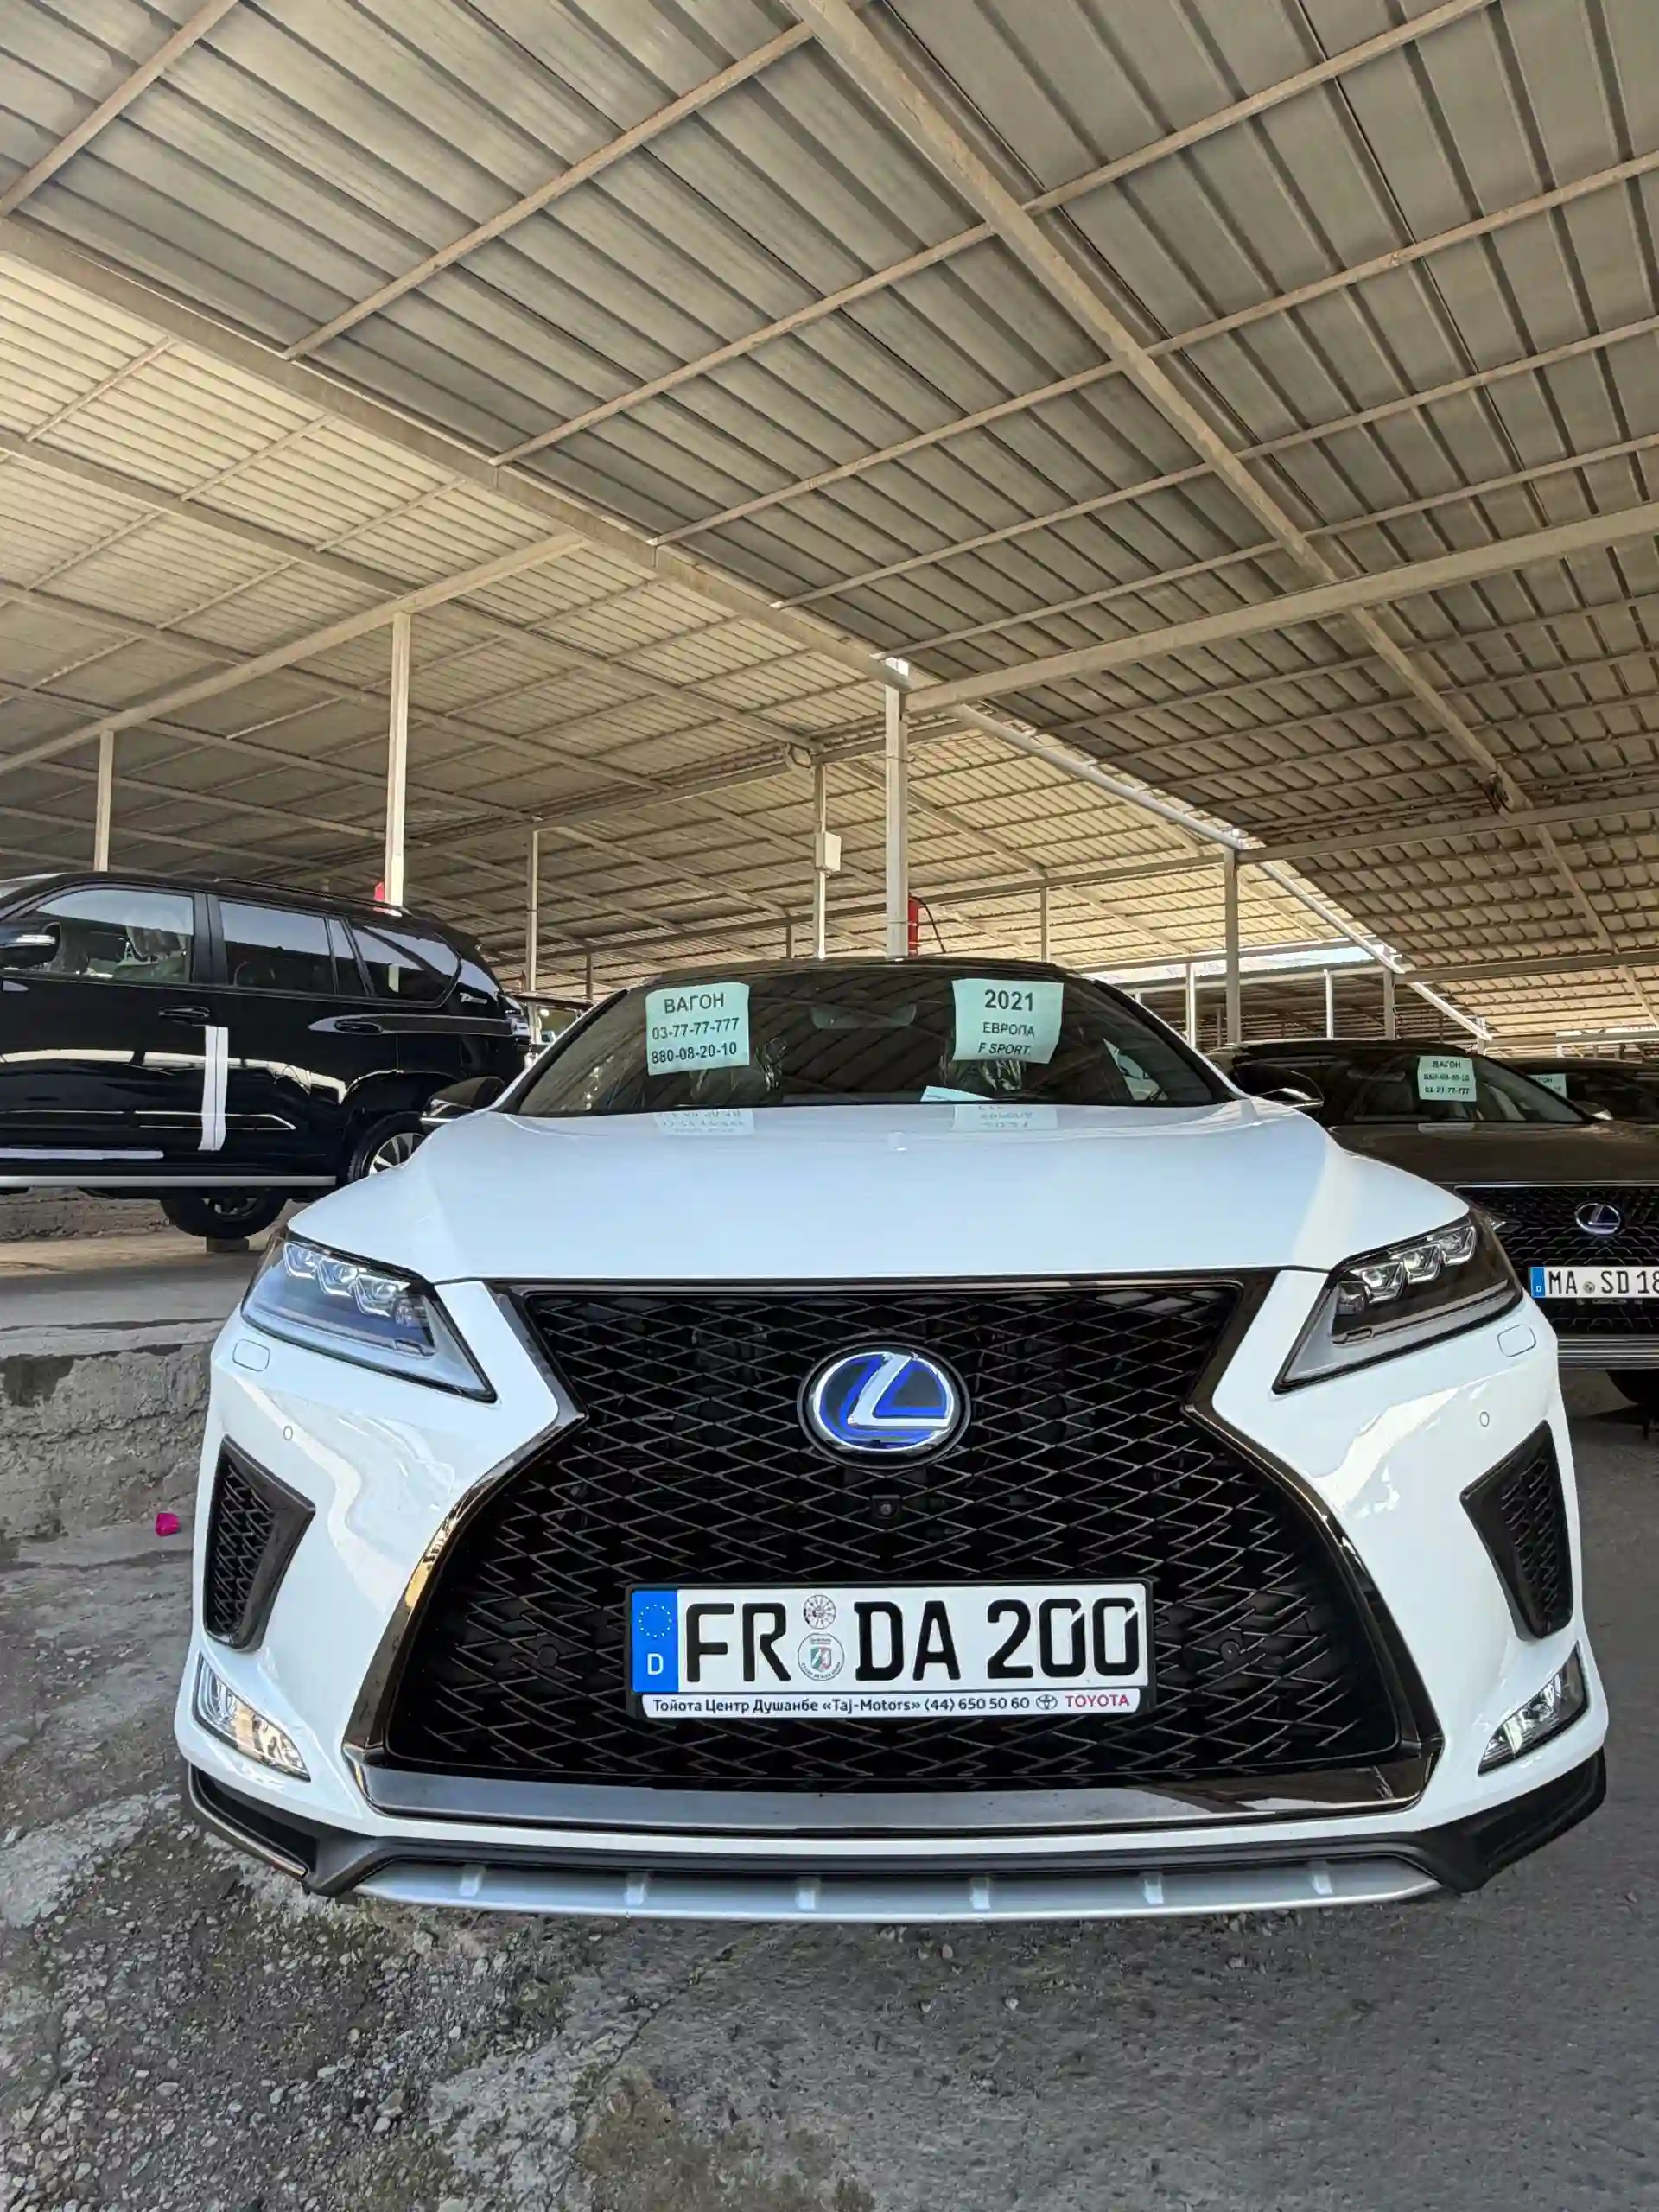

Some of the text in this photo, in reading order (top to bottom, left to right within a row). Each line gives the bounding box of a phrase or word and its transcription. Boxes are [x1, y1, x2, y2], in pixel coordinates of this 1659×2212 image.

[664, 992, 725, 1014] ВАГОН
[984, 989, 1034, 1012] 2021
[652, 1017, 740, 1040] 03-77-77-777
[982, 1021, 1035, 1038] ЕВРОПА
[651, 1041, 737, 1065] 880-08-20-10
[977, 1042, 988, 1053] F
[1548, 1270, 1579, 1294] MA
[1600, 1270, 1630, 1294] SD
[647, 1597, 1139, 1683] D FR DA 200
[652, 1694, 1130, 1715] Тойота Центр Душанбе «Taj-Motors» (44) 650 50 60 TOYOTA
